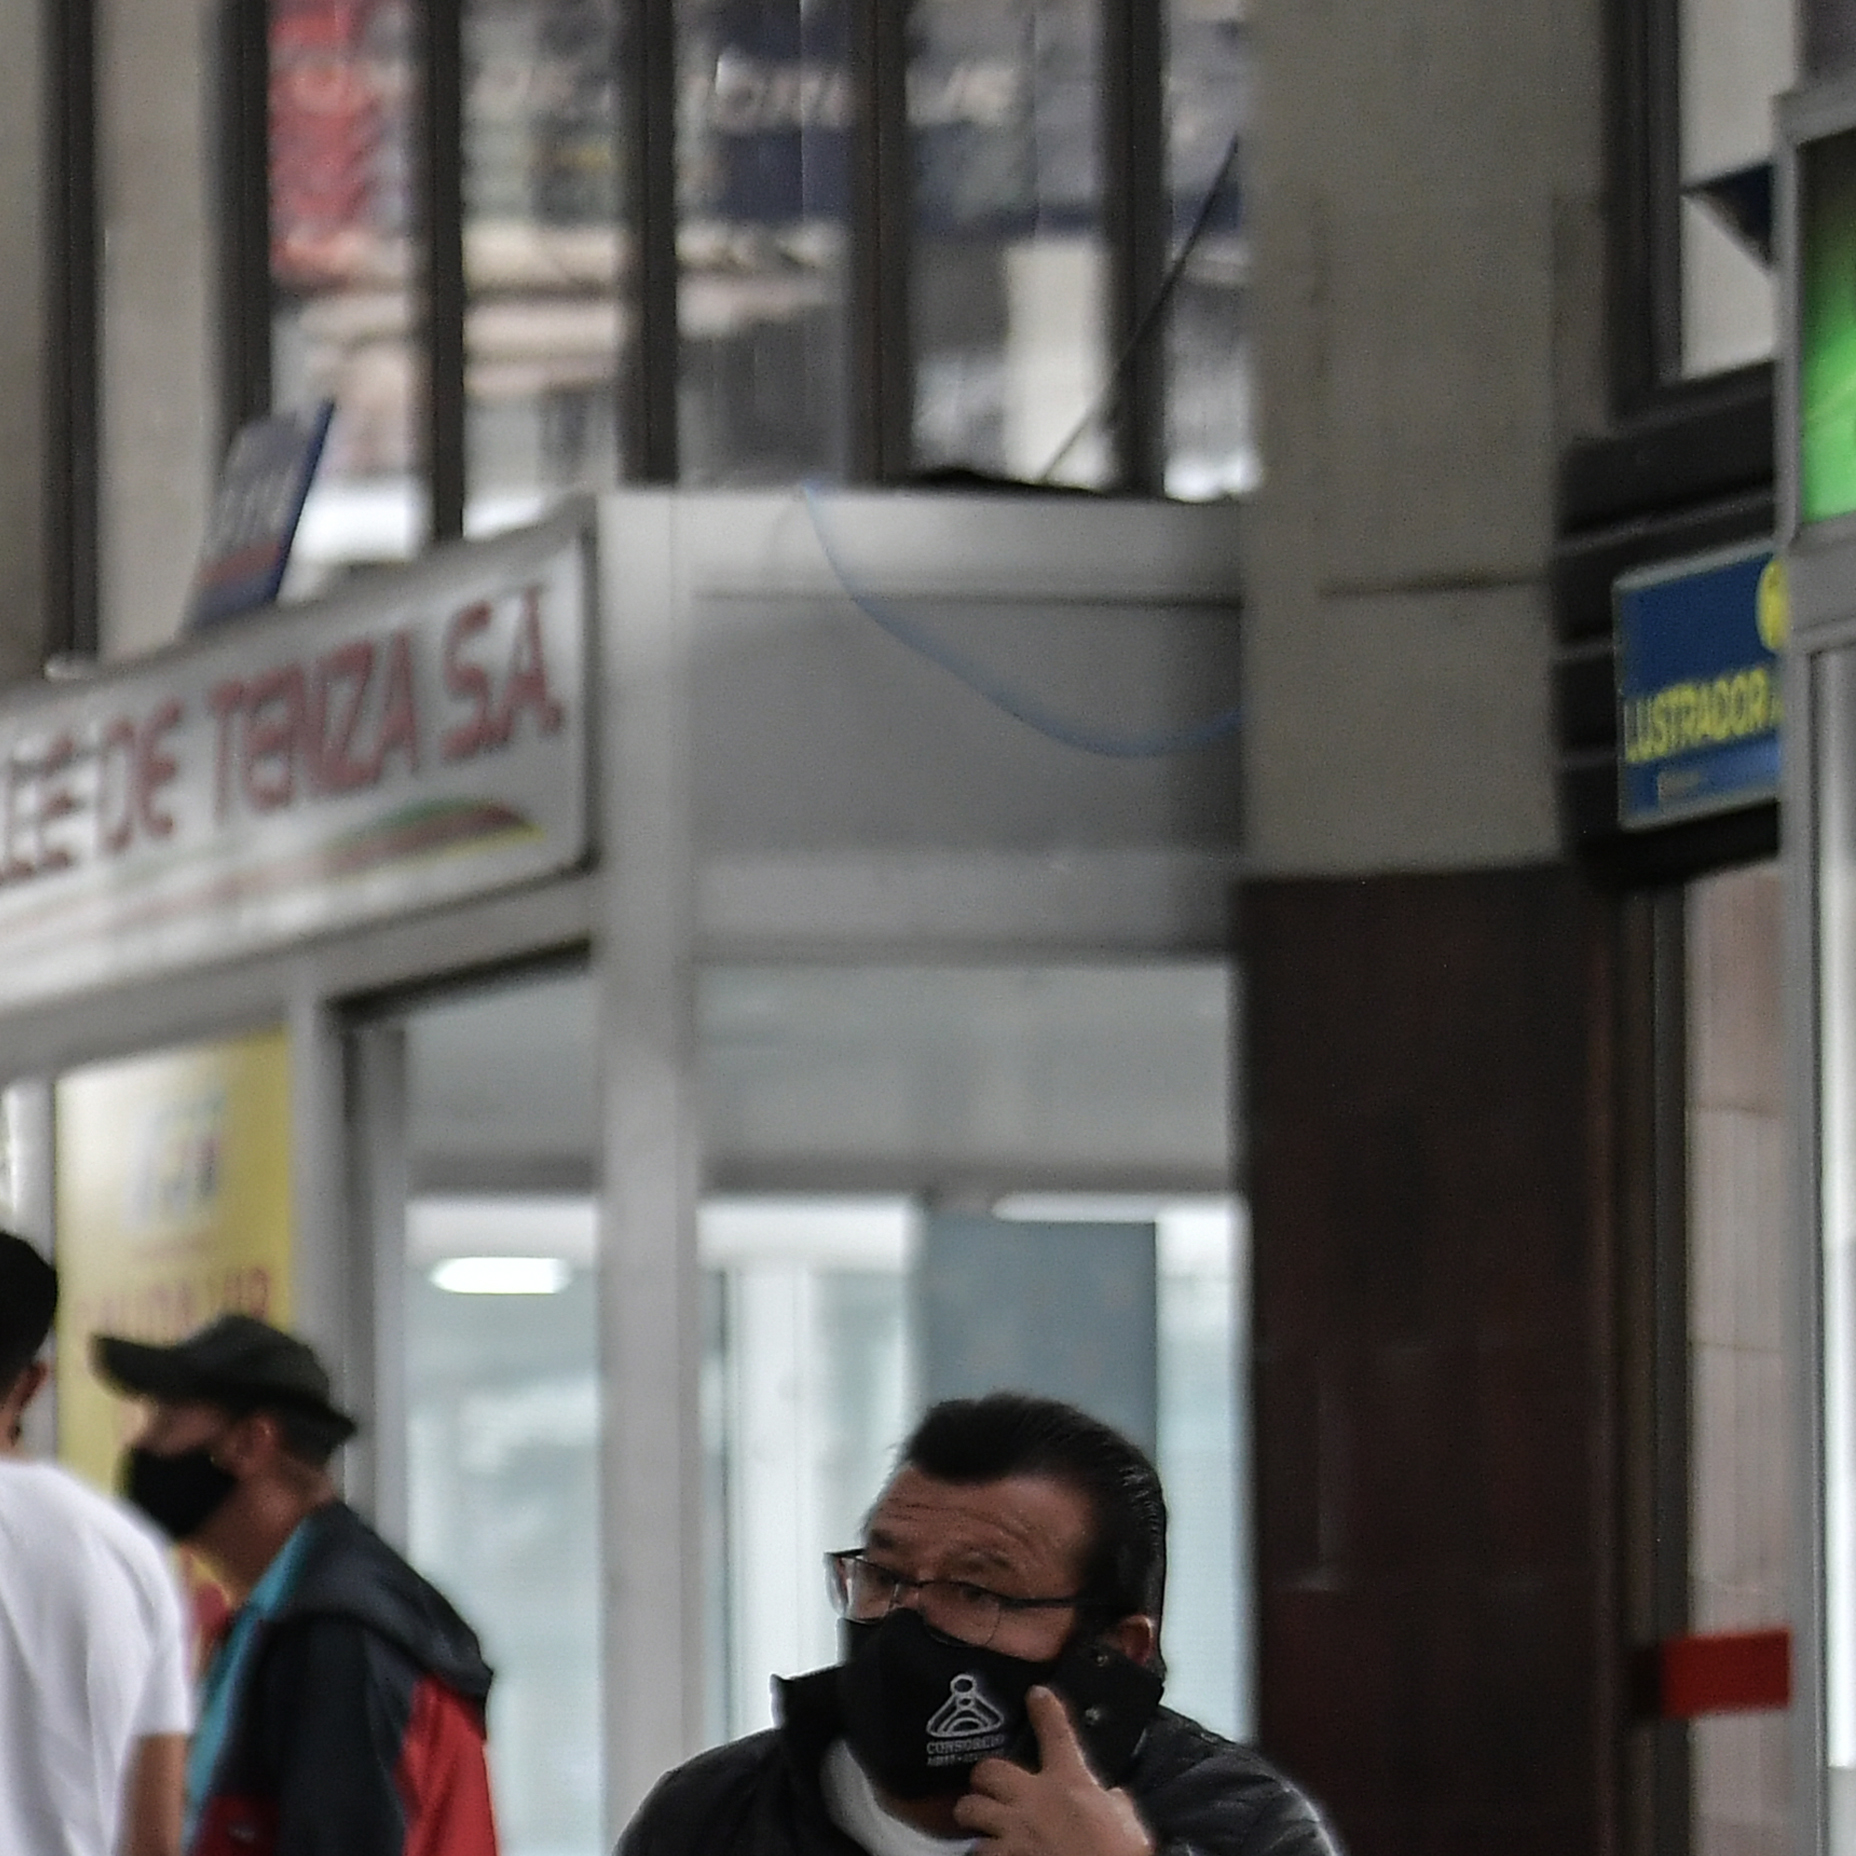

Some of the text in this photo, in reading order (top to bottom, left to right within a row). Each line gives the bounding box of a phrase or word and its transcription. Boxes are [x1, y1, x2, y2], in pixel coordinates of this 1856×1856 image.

[96, 703, 182, 845] DE
[206, 638, 420, 818] TENZA
[1624, 666, 1783, 764] LUSTRADOR
